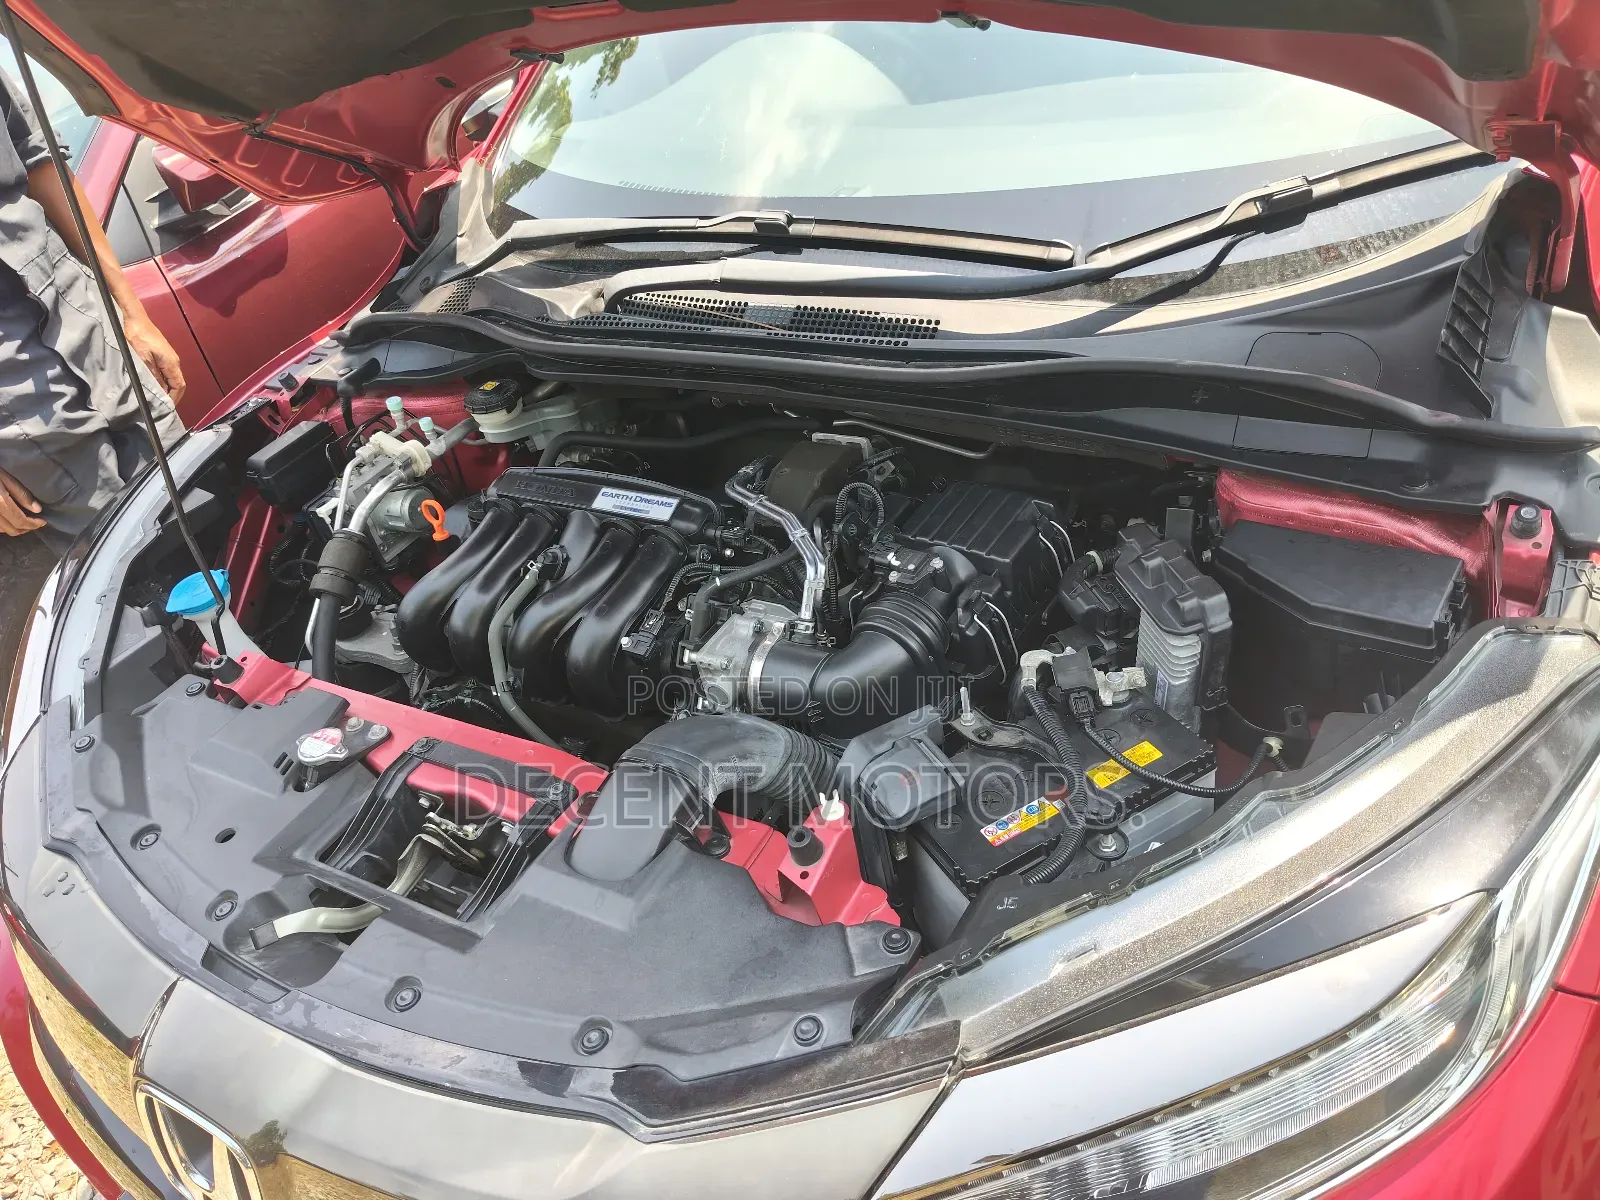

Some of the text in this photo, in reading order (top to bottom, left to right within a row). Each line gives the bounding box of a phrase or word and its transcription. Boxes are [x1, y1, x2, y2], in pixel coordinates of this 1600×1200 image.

[515, 480, 575, 498] HONDA
[601, 491, 633, 502] EARTH
[633, 495, 674, 508] DREAMS
